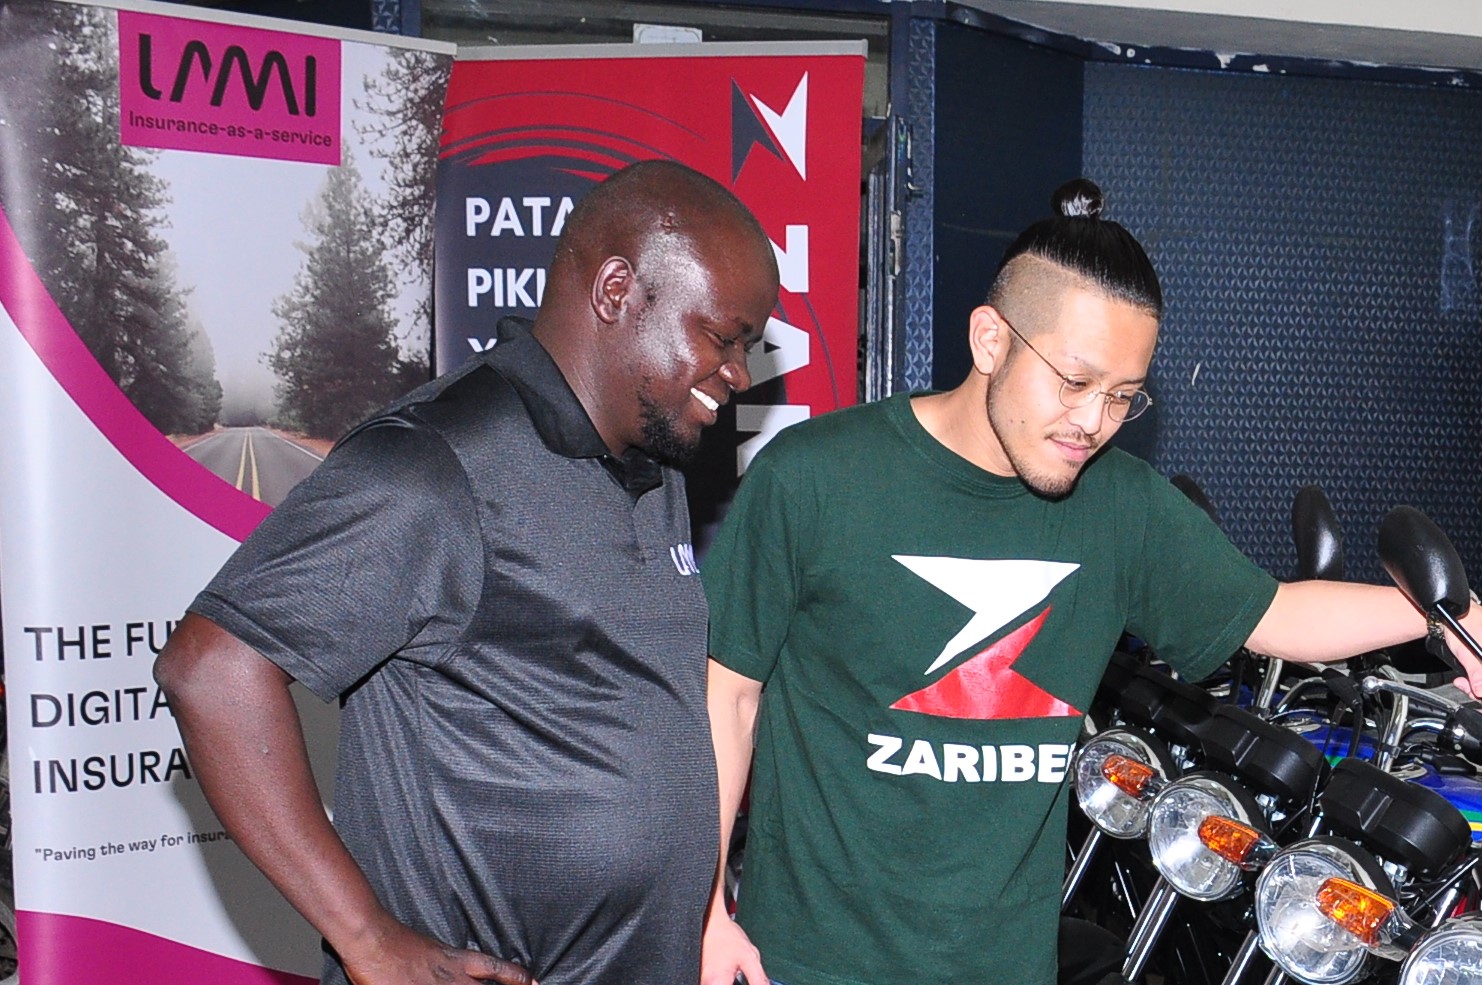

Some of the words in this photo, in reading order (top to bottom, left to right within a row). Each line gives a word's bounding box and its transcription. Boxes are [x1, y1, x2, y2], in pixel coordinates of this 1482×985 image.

[138, 33, 317, 118] LAMI
[129, 110, 333, 147] Insurance-as-a-service
[24, 624, 112, 661] THE
[126, 619, 182, 657] FU
[33, 747, 192, 794] INSURA
[866, 733, 1077, 783] ZARIBE
[100, 841, 125, 856] the
[128, 837, 157, 854] way
[160, 833, 184, 848] for
